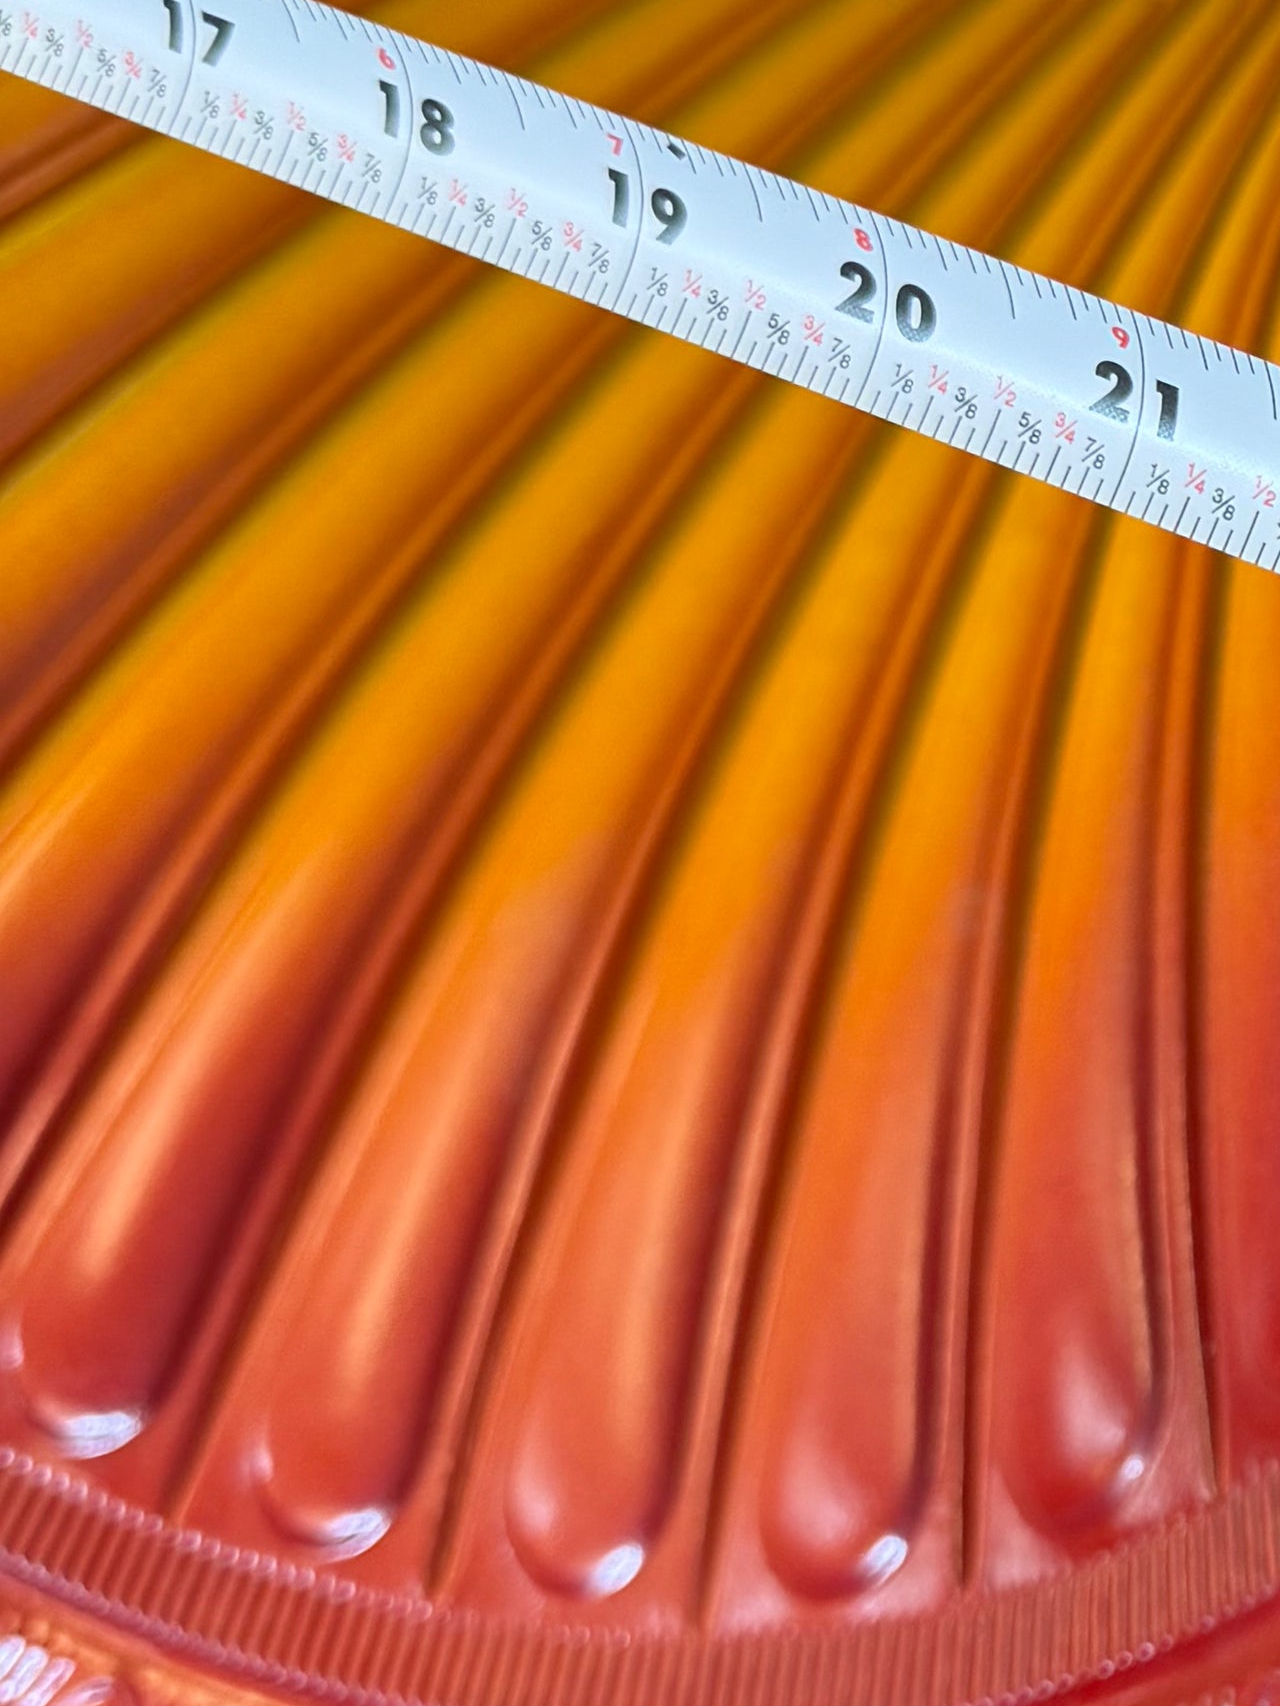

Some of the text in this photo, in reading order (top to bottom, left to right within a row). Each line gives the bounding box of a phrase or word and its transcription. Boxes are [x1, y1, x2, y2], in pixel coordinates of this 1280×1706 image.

[377, 48, 396, 70] 6
[607, 133, 624, 155] 7
[852, 227, 873, 252] 8
[1112, 326, 1130, 348] 9
[379, 78, 455, 156] 18
[608, 167, 688, 245] 19
[835, 261, 937, 343] 20
[1089, 361, 1180, 441] 21
[420, 176, 438, 205] 1/8
[450, 179, 468, 207] 1/4
[474, 198, 496, 228] 3/8
[509, 188, 528, 218] 1/2
[531, 220, 553, 251] 5/8
[563, 222, 584, 252] 3/4
[588, 242, 610, 273] 7/8
[647, 267, 668, 296] 1/8
[682, 269, 702, 298] 1/4
[707, 290, 729, 321] 3/8
[744, 280, 766, 310] 1/2
[767, 313, 790, 345] 5/8
[801, 315, 825, 346] 3/4
[828, 338, 851, 369] 7/8
[891, 364, 913, 394] 1/8
[923, 365, 948, 395] 1/4
[955, 387, 978, 419] 3/8
[993, 376, 1017, 407] 1/2
[1018, 412, 1042, 444] 5/8
[1055, 412, 1078, 444] 3/4
[1081, 437, 1105, 469] 7/8
[1146, 464, 1170, 494] 1/8
[1185, 463, 1207, 494] 1/4
[1212, 488, 1235, 521] 3/8
[1252, 476, 1277, 507] 1/2
